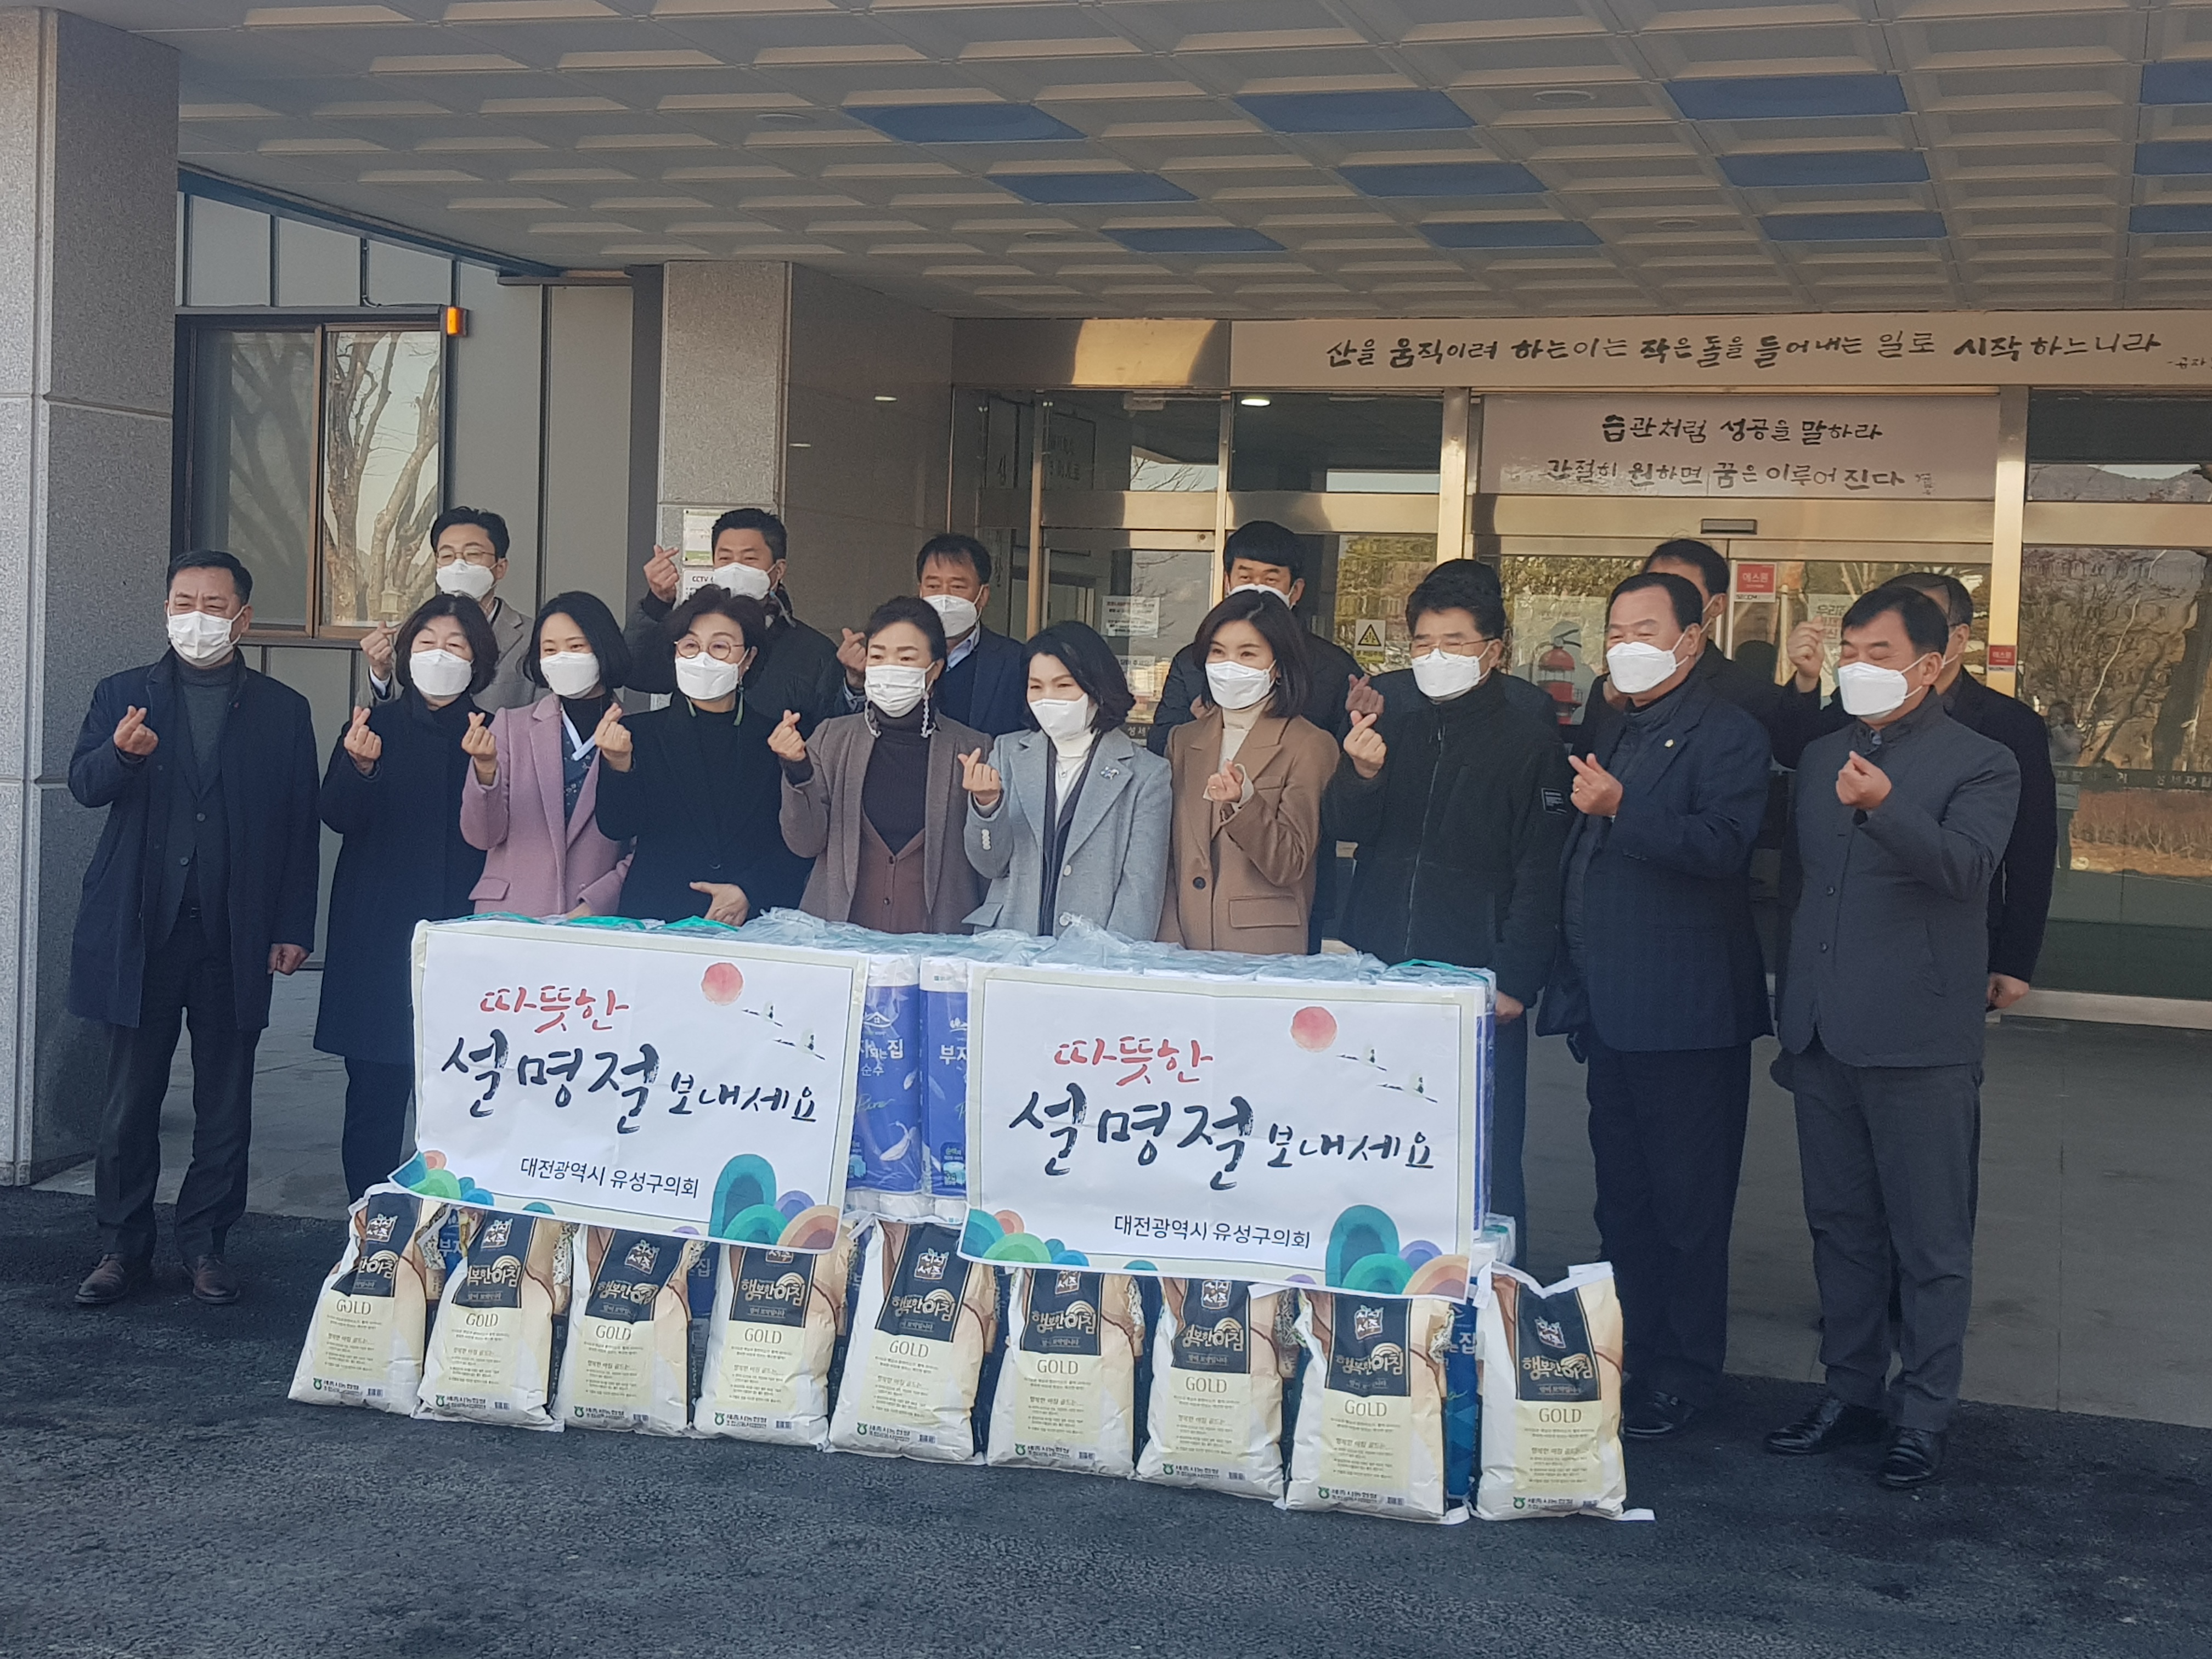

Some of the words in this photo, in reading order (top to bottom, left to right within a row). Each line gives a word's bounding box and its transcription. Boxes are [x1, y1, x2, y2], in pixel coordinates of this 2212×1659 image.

[1327, 338, 1375, 368] 산을
[1389, 337, 1498, 368] 움직이려
[1753, 335, 1863, 369] 들어내는
[1877, 330, 1935, 359] 일로
[1601, 414, 1707, 444] 습관처럼
[1719, 418, 1791, 442] 성공을
[1802, 420, 1883, 445] 말하라
[1547, 459, 1617, 483] 간절히
[1628, 462, 1702, 487] 원하면
[1713, 462, 1758, 489] 꿈은
[1742, 572, 1768, 583] 에스원
[480, 985, 629, 1033] 따뜻한
[861, 1063, 885, 1076] 순수
[1054, 1036, 1214, 1086] 따뜻한
[669, 1071, 817, 1122] 보내세요
[1268, 1122, 1434, 1169] 보내세요
[520, 1158, 606, 1187] 대전광역시
[610, 1170, 699, 1199] 유성구의회
[1114, 1215, 1207, 1241] 대전광역시
[1213, 1222, 1310, 1249] 유성구의회
[336, 1299, 371, 1315] GOLD
[466, 1313, 499, 1328] GOLD
[596, 1324, 631, 1340] GOLD
[745, 1328, 782, 1344] GOLD
[889, 1340, 929, 1358] GOLD
[1037, 1359, 1079, 1375] GOLD
[1186, 1376, 1227, 1393] GOLD
[1344, 1399, 1387, 1418] GOLD
[1539, 1408, 1582, 1423] GOLD
